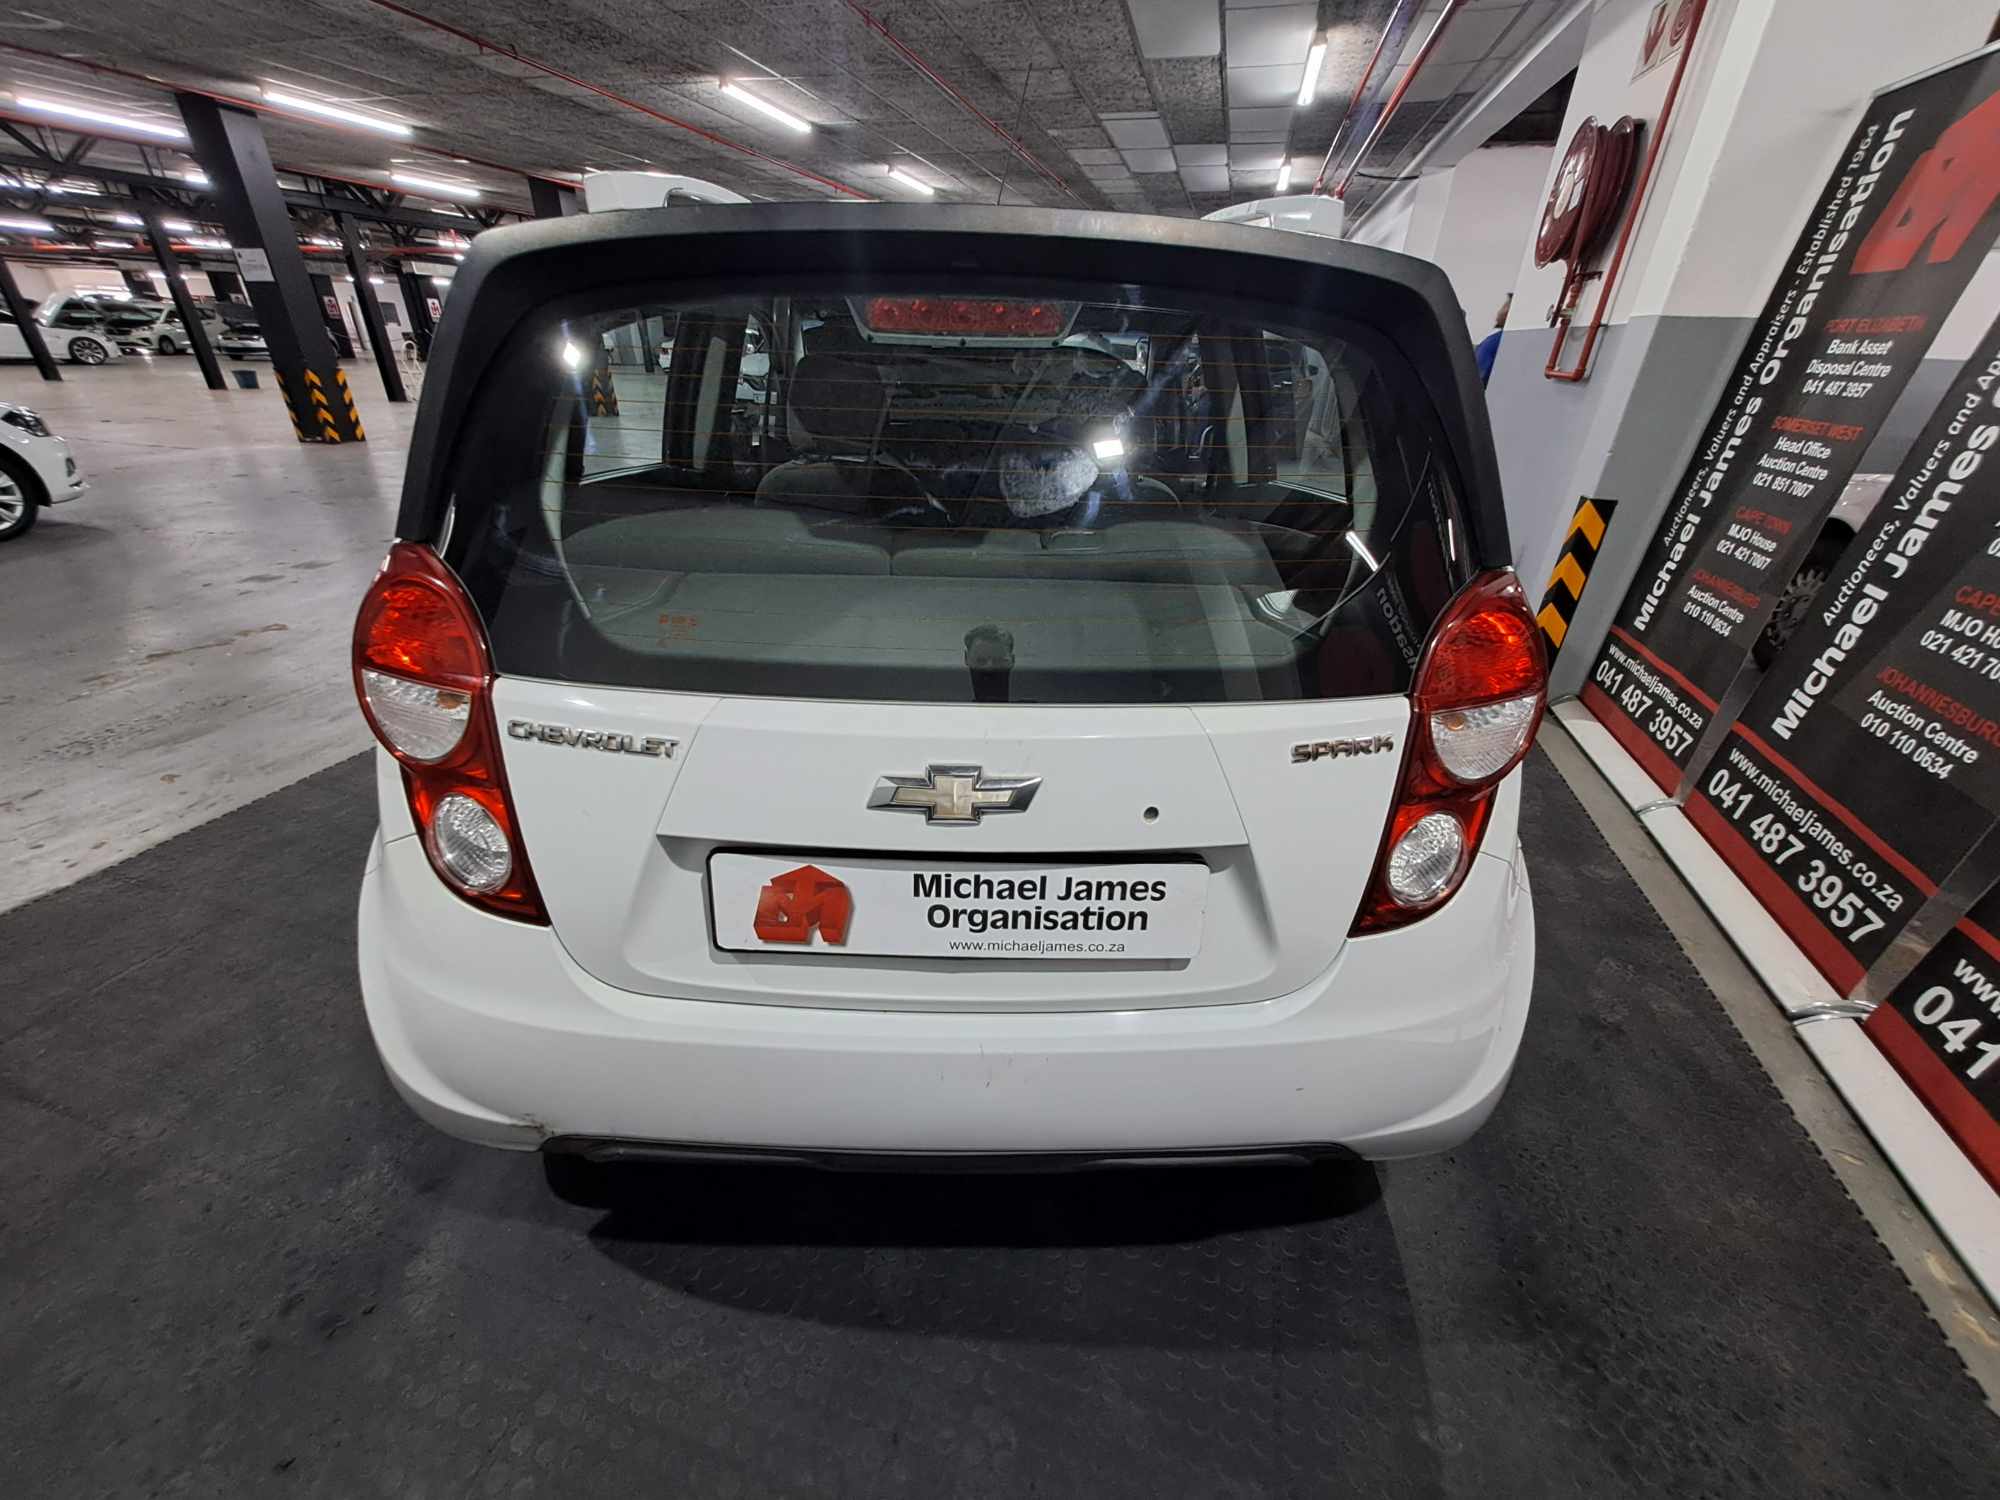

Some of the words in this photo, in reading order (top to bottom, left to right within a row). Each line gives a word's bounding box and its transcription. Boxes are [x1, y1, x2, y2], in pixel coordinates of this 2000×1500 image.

[1663, 466, 1709, 547] Auctioneers,
[1703, 408, 1737, 461] Valuers
[1734, 374, 1754, 405] and
[1749, 289, 1797, 373] Appraisers
[1796, 176, 1853, 275] Established
[1848, 123, 1880, 171] 1964
[1826, 339, 1860, 354] Bank
[1857, 339, 1894, 355] Asset
[1633, 512, 1701, 631] Michael
[1699, 396, 1763, 508] James
[1759, 108, 1917, 385] Organisation
[1806, 359, 1856, 378] Disposal
[1852, 360, 1892, 378] Centre
[1757, 453, 1797, 473] Auction
[1795, 461, 1828, 480] Centre
[1774, 436, 1805, 453] Head
[1801, 440, 1832, 459] Office
[1752, 471, 1774, 488] 021
[1771, 476, 1793, 492] 851
[1823, 519, 1901, 627] Auctioneers,
[1894, 439, 1951, 511] Valuers
[1947, 392, 1981, 435] and
[1716, 539, 1736, 555] 021
[1727, 523, 1752, 541] MJO
[1749, 531, 1777, 552] House
[1771, 583, 1889, 740] Michael
[1883, 424, 2000, 578] James
[1683, 601, 1701, 618] 010
[1687, 585, 1720, 609] Auction
[1718, 600, 1744, 624] Centre
[1940, 609, 1985, 637] MJO
[1920, 629, 1954, 654] 021
[1951, 644, 1985, 669] 421
[1608, 643, 1703, 729] www.michaeljames.co.za
[1596, 660, 1624, 695] 041
[1620, 683, 1653, 718] 487
[1648, 708, 1694, 757] 3957
[1867, 689, 1925, 731] Auction
[1924, 722, 1978, 764] Centre
[507, 719, 680, 759] CHEVROLET
[1290, 734, 1394, 764] SPARK
[1861, 712, 1890, 737] 010
[1889, 730, 1917, 754] 110
[1912, 746, 1955, 780] 0634
[1728, 747, 1904, 913] www.michaeljames.co.za
[1708, 769, 1754, 820] 041
[1750, 813, 1806, 865] 487
[1798, 859, 1886, 943] 3957
[912, 873, 1048, 901] Michael
[1056, 876, 1167, 901] James
[927, 903, 1149, 933] Organisation
[949, 939, 1125, 955] www.michaeljames.co.za
[1913, 985, 2000, 1080] 041
